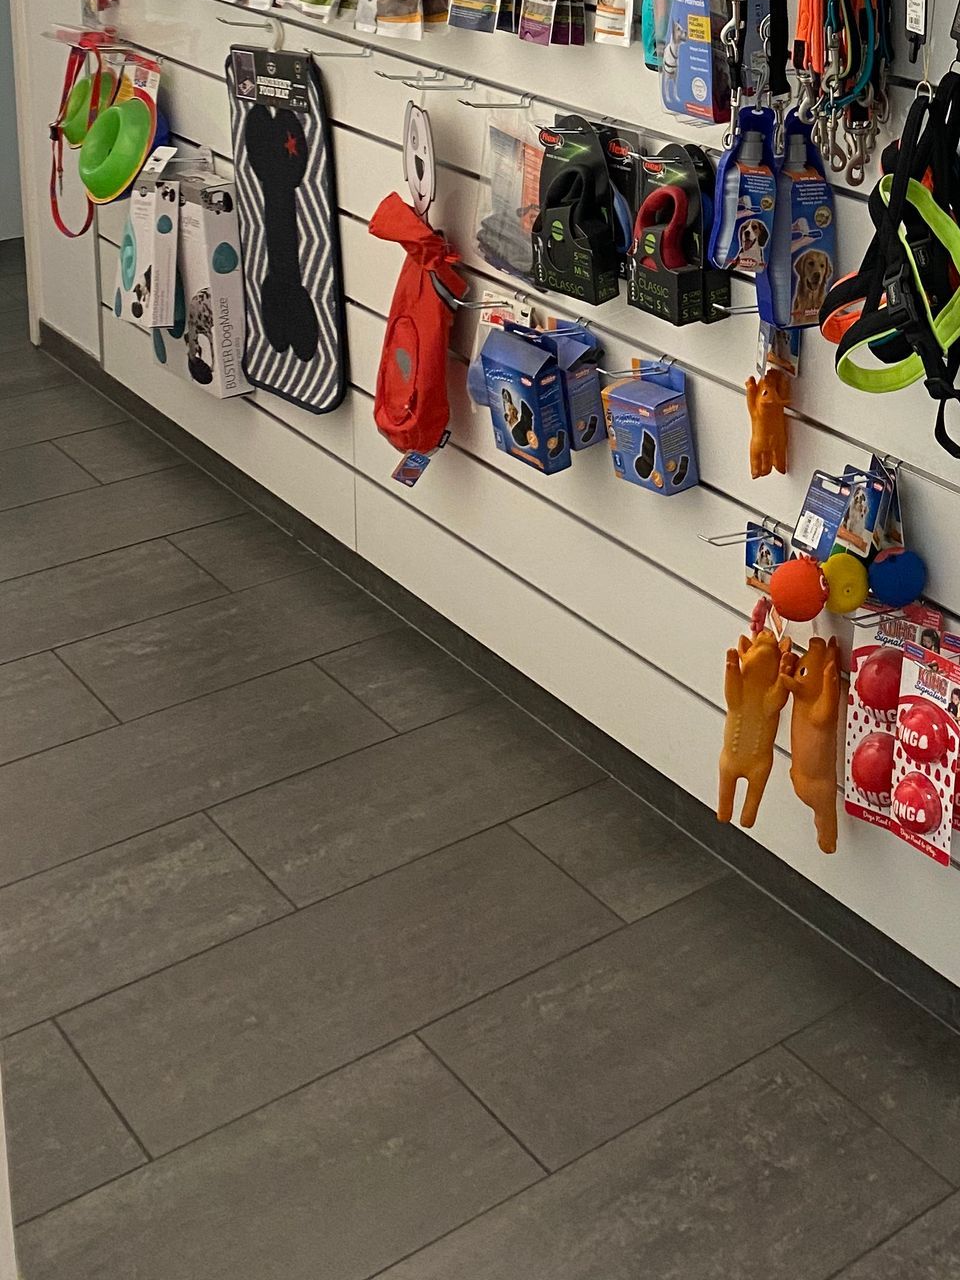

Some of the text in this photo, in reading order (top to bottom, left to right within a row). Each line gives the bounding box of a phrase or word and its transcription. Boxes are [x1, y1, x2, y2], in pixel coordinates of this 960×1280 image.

[549, 275, 584, 297] CLASSIC
[638, 277, 670, 299] CLASSIC
[217, 297, 233, 348] DogMaze
[220, 349, 236, 391] BUSTER
[874, 630, 905, 649] Signat
[914, 681, 948, 706] Signature
[893, 799, 917, 822] ONG
